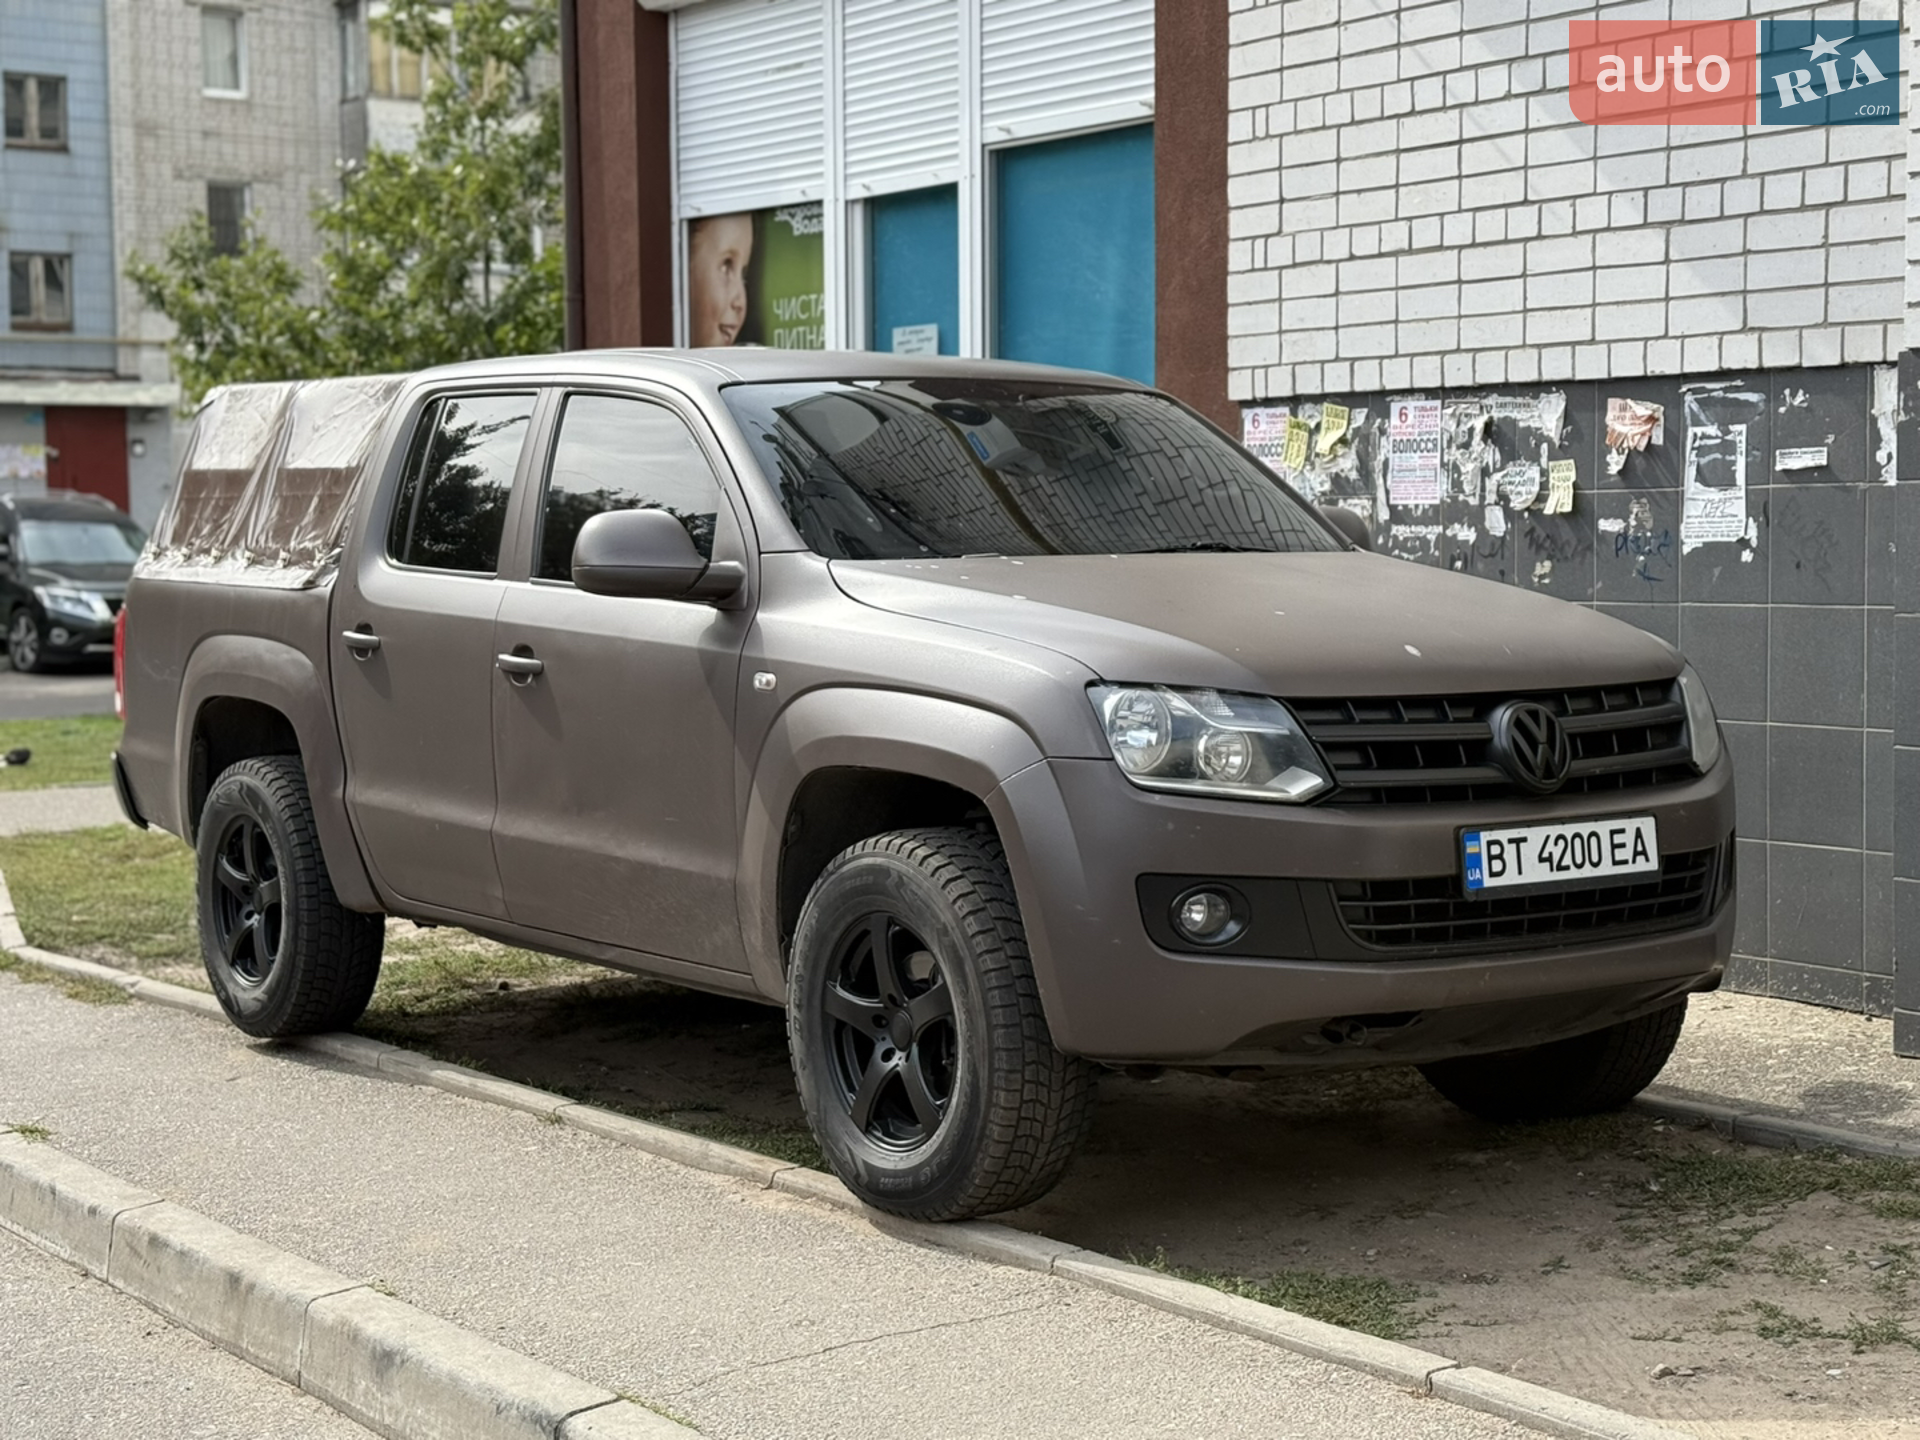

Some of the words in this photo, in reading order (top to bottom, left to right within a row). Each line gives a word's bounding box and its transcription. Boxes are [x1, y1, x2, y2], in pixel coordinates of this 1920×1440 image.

[1251, 412, 1261, 429] 6
[1398, 405, 1409, 424] 6
[1392, 438, 1438, 454] ВОЛОССЯ
[1486, 836, 1528, 878] BT
[1538, 831, 1603, 873] 4200
[1609, 826, 1650, 866] EA
[1467, 868, 1482, 882] UA
